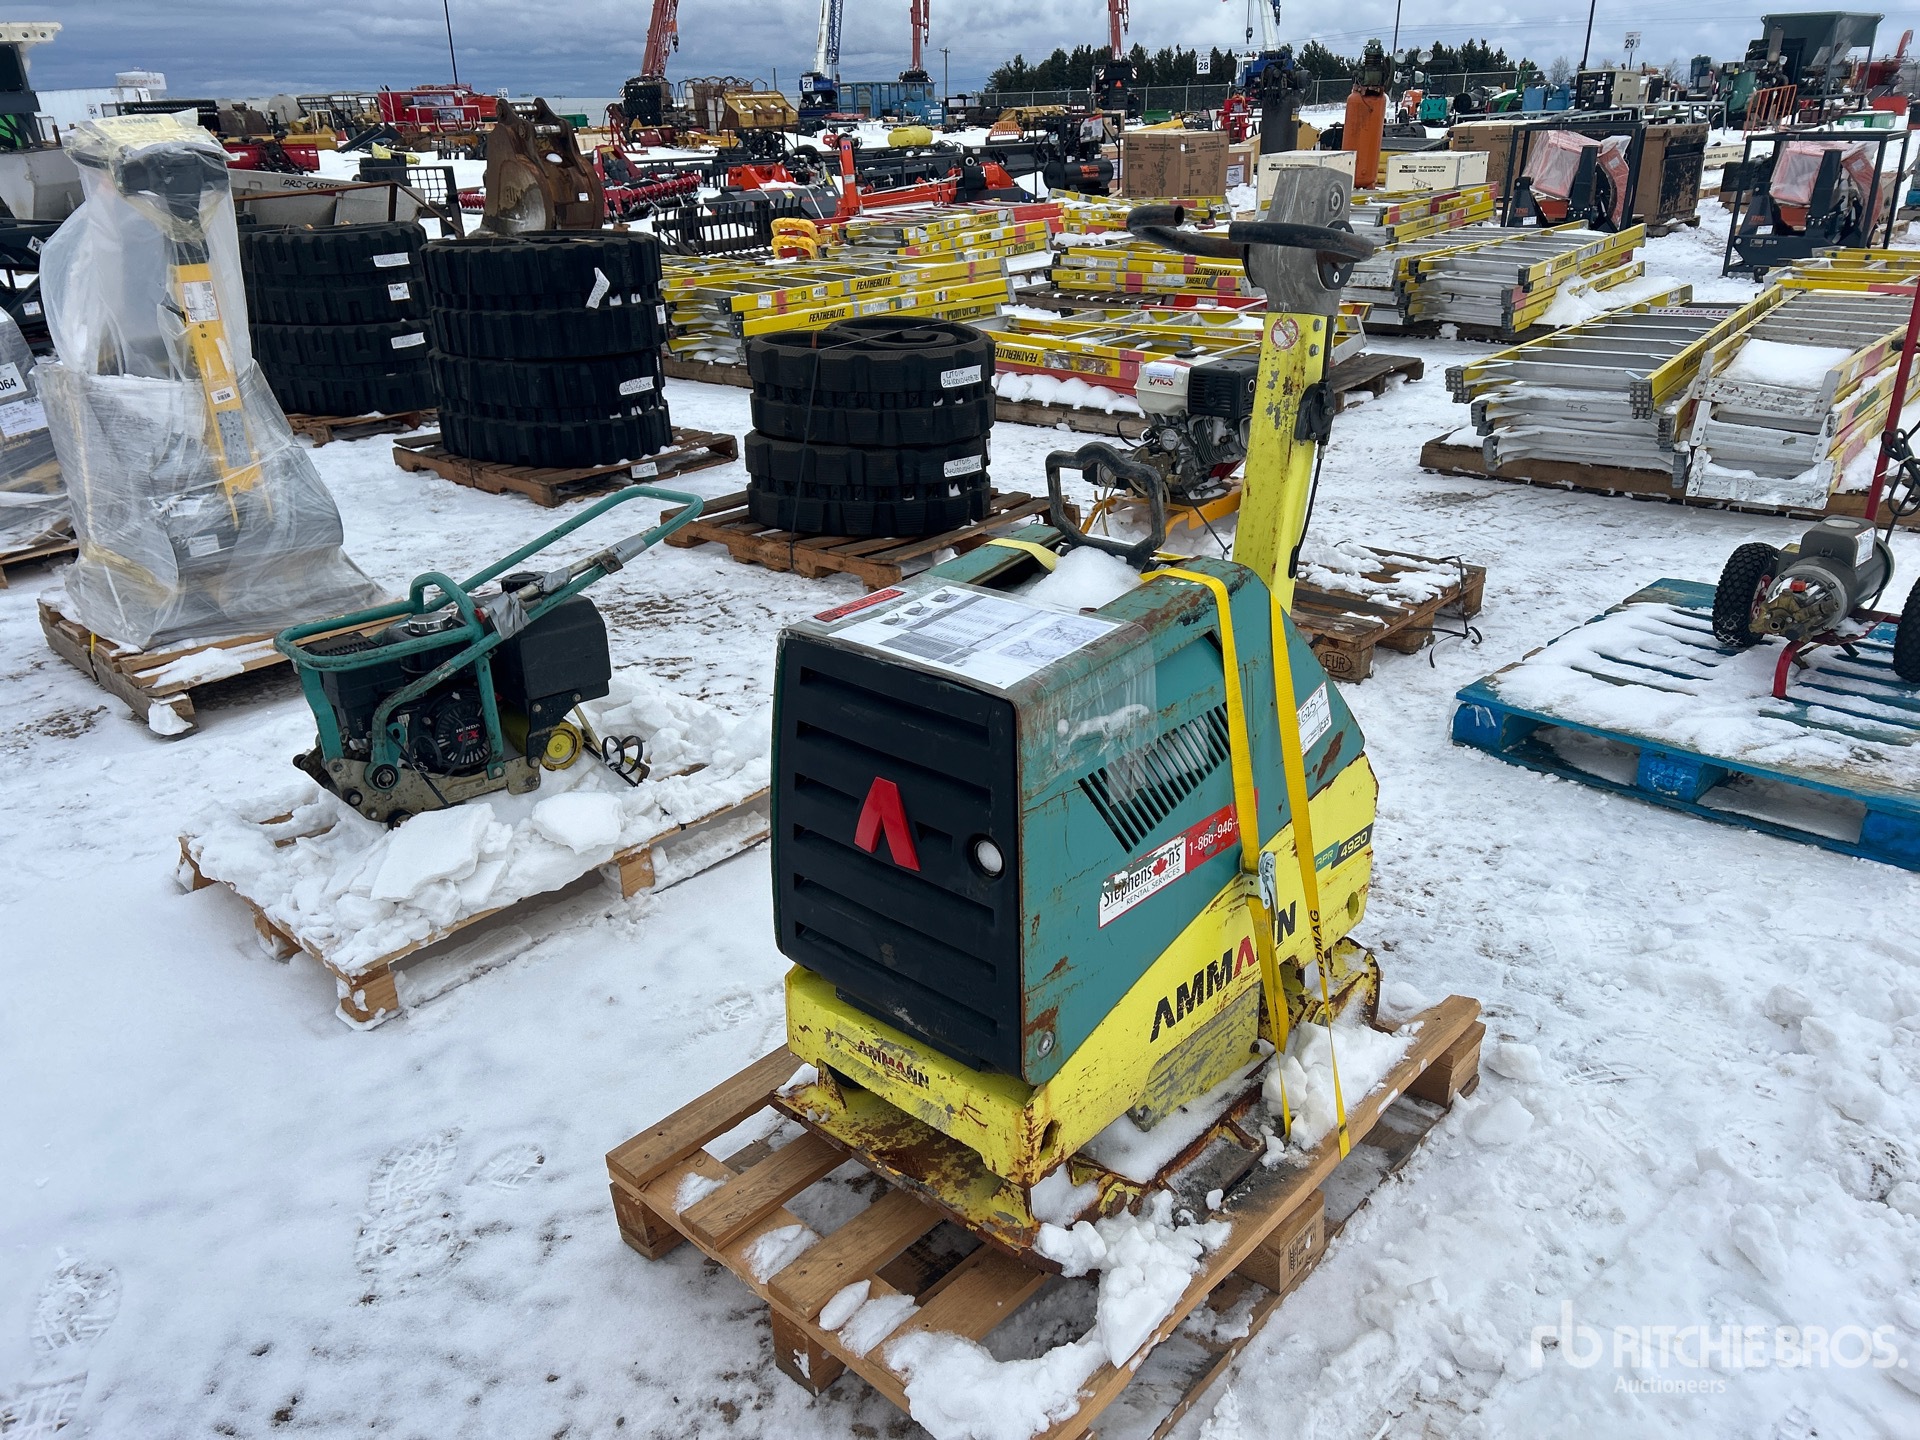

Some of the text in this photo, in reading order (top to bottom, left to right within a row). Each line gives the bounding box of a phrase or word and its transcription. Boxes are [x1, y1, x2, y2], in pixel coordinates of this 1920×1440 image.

[1624, 39, 1635, 49] 29
[1198, 61, 1209, 71] 28
[803, 81, 813, 89] 27
[856, 275, 893, 291] FEATHERLITE
[808, 307, 846, 323] FEATHERLITE
[995, 345, 1039, 364] FEATHERLITE
[1325, 654, 1346, 671] EUR
[1189, 817, 1240, 856] 1-866-946-
[1340, 831, 1368, 857] 4920
[1315, 849, 1334, 868] APR
[1126, 866, 1180, 906] RENTAL SERVICES
[1309, 909, 1325, 979] BOMAG
[1149, 900, 1297, 1043] AMMAN
[857, 1040, 930, 1091] AMMANN
